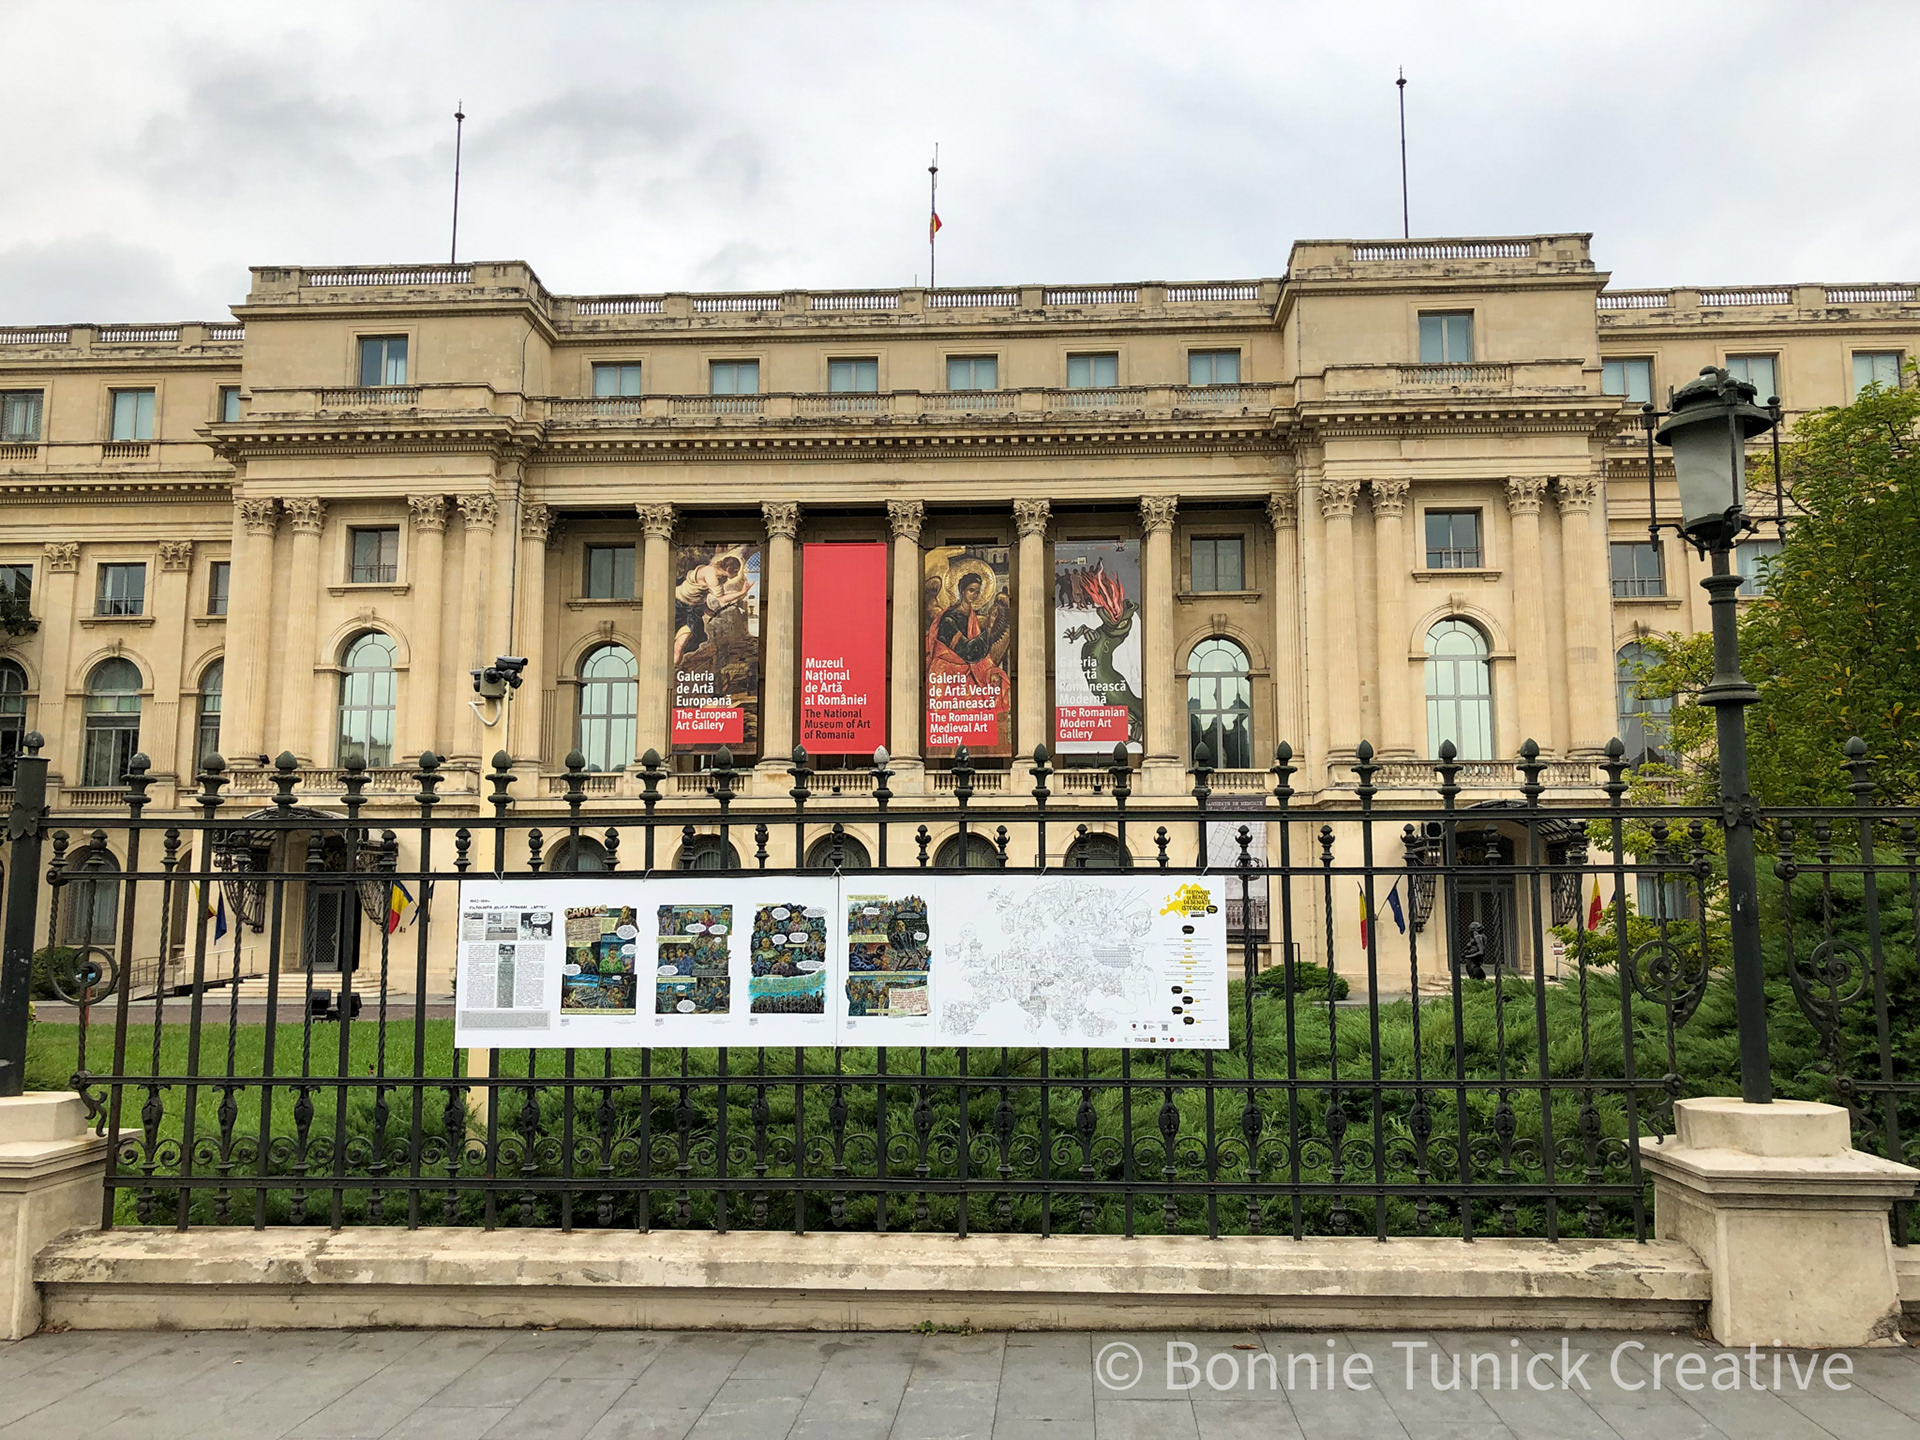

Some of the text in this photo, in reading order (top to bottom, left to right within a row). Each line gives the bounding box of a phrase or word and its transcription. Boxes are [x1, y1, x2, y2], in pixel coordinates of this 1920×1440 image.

[805, 657, 844, 669] Muzeul
[676, 670, 715, 682] Galeria
[805, 669, 850, 684] Național
[929, 672, 967, 684] Galeria
[676, 681, 715, 694] de Artă
[805, 681, 843, 693] de Artă
[929, 684, 1001, 697] de Artă Veche
[676, 694, 732, 709] Europeană
[804, 693, 867, 706] al României
[929, 696, 996, 710] Românească
[676, 709, 738, 722] The European
[805, 708, 863, 719] The National
[930, 711, 995, 722] The Romanian
[1060, 707, 1125, 718] The Romanian
[675, 719, 725, 732] Art Gallery
[804, 719, 871, 729] Museum of Art
[929, 722, 988, 733] Medieval Art
[1060, 718, 1112, 728] Modern Art
[804, 729, 855, 740] of Romania
[930, 734, 963, 746] Gallery
[1060, 729, 1093, 741] Gallery
[564, 905, 607, 918] CARITAS
